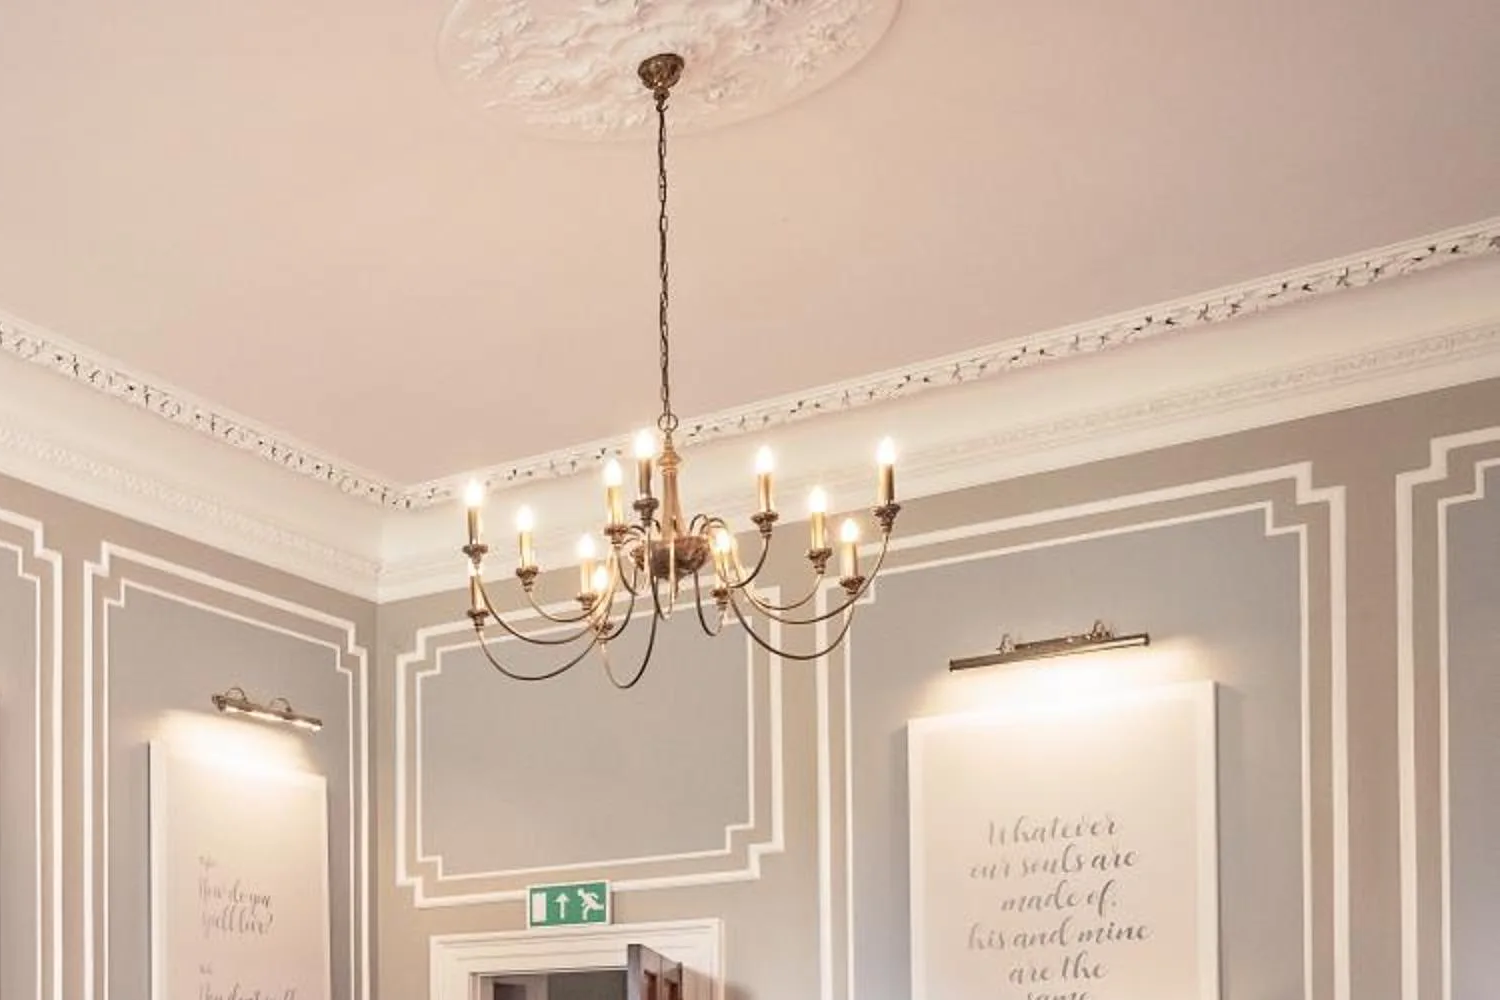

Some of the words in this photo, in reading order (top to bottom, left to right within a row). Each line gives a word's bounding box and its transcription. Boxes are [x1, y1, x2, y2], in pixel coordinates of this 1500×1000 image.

[987, 814, 1121, 847] Whatever
[968, 862, 1011, 881] our
[1020, 842, 1086, 878] souls
[1090, 849, 1141, 871] are
[1000, 878, 1079, 912] made
[967, 921, 1007, 950] his
[1012, 915, 1075, 949] and
[1076, 921, 1155, 945] mine
[1008, 965, 1054, 985] are
[1060, 949, 1110, 980] the
